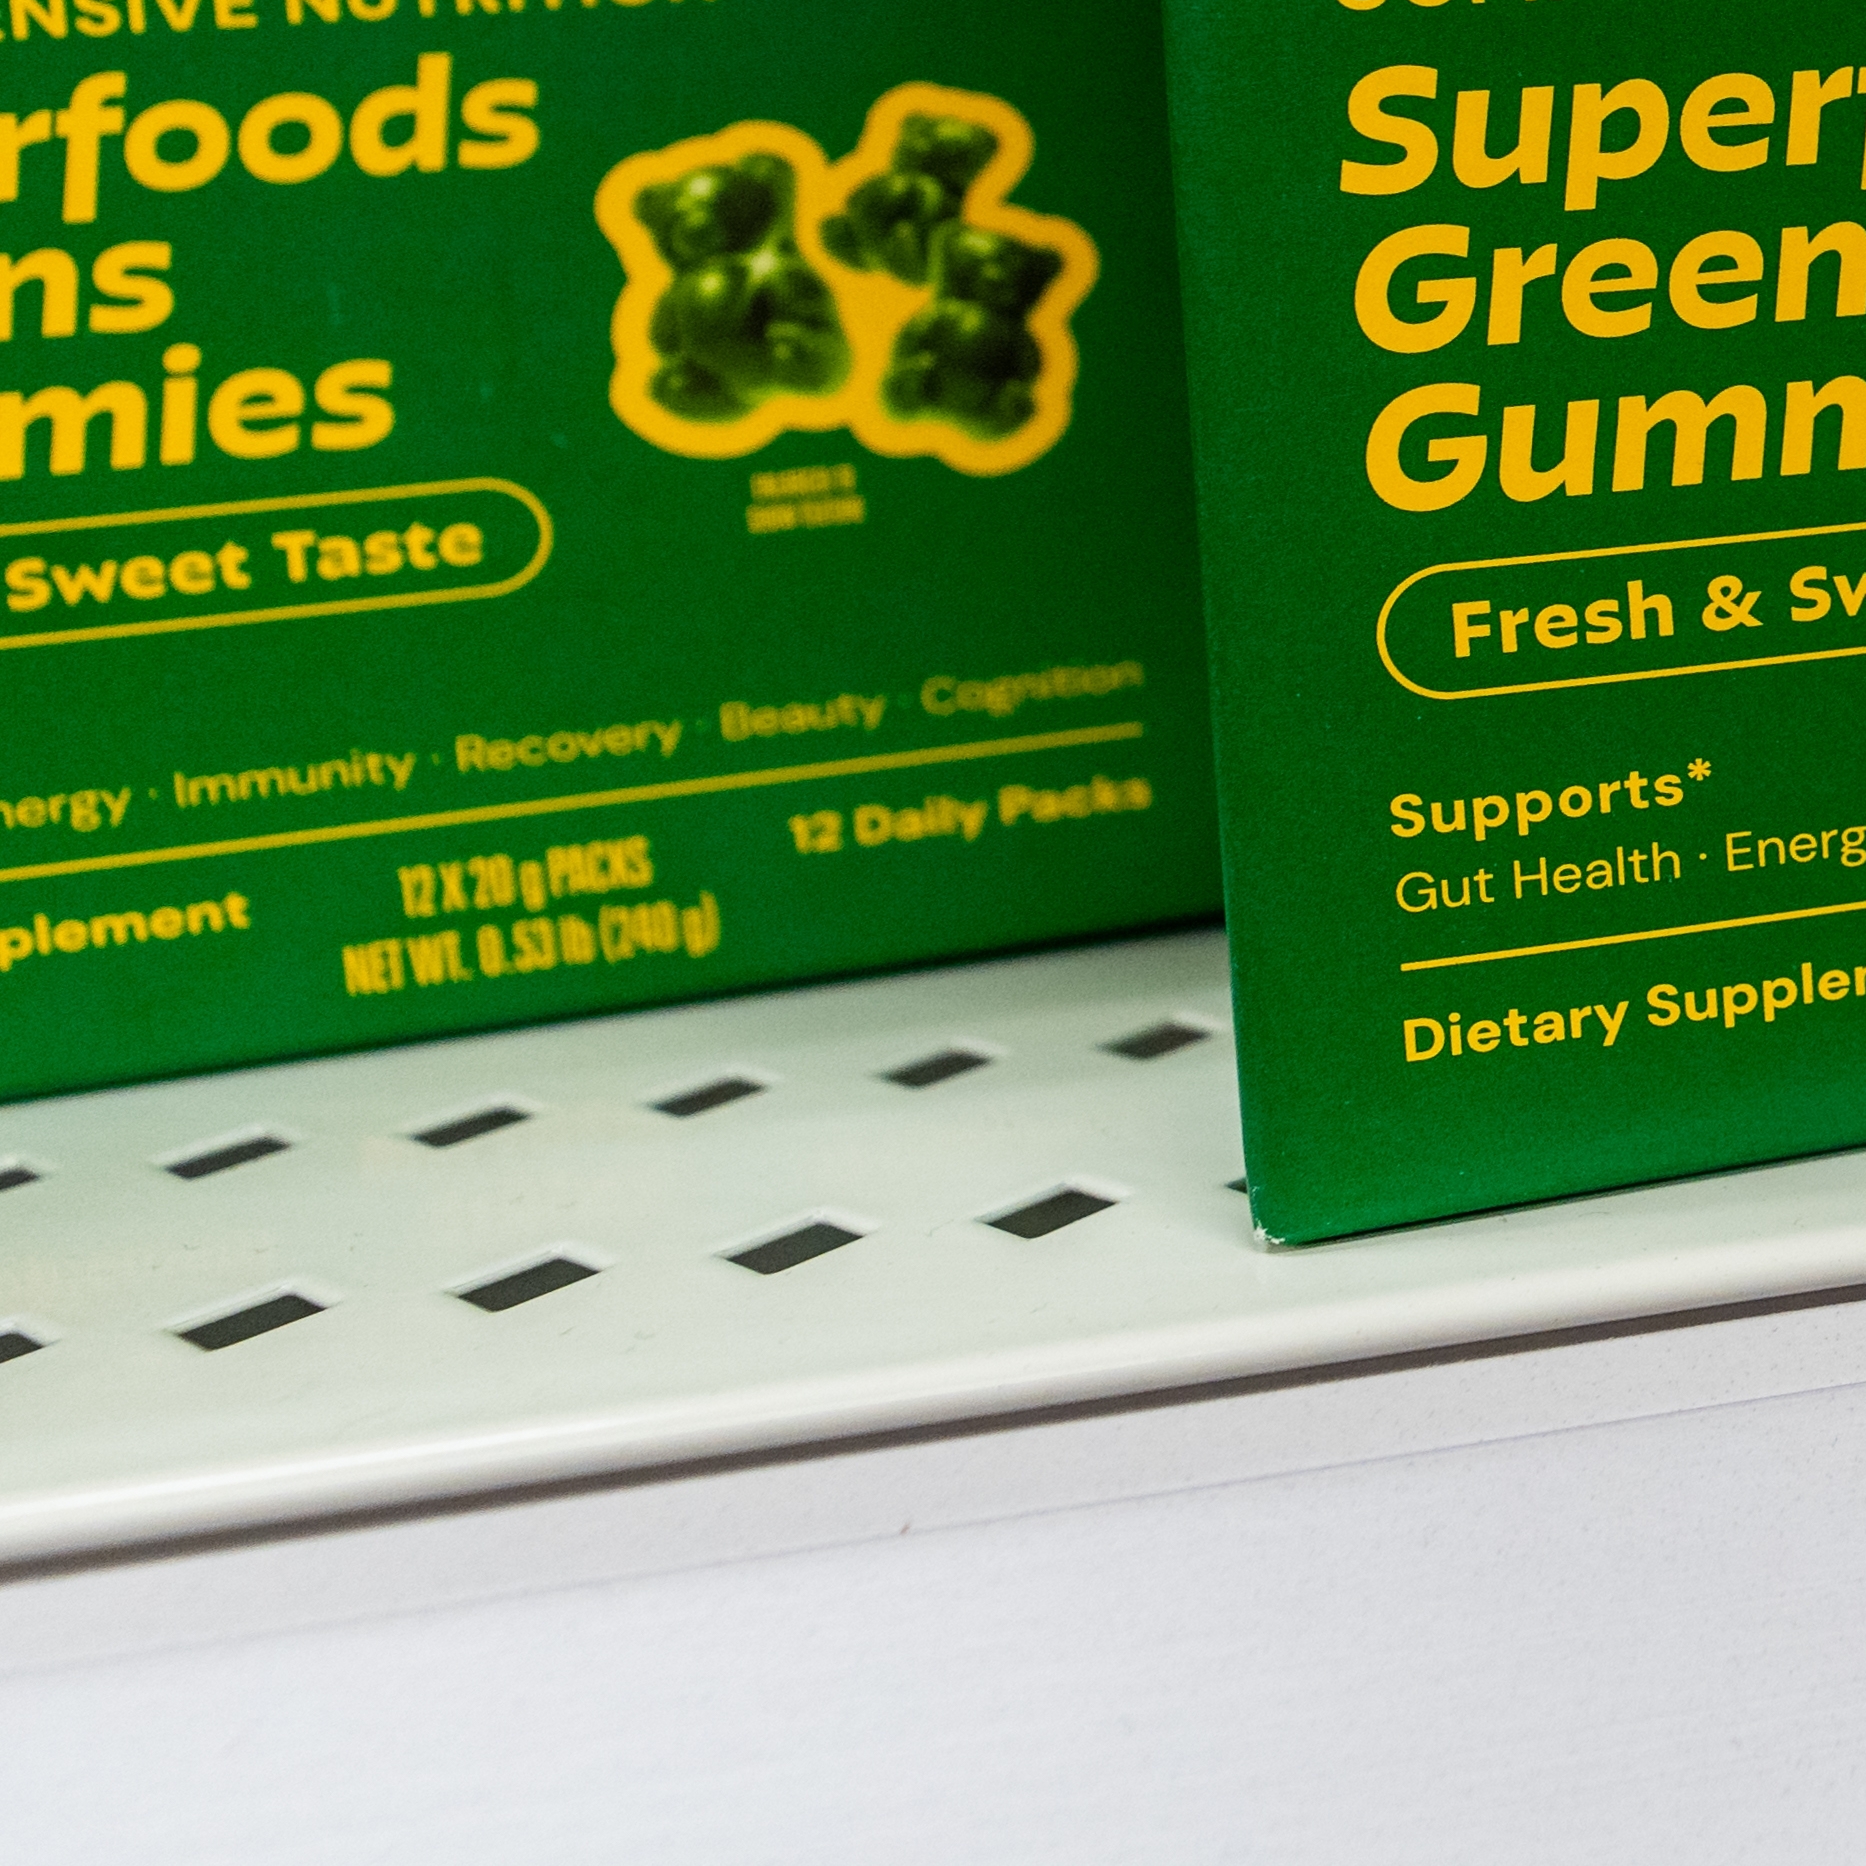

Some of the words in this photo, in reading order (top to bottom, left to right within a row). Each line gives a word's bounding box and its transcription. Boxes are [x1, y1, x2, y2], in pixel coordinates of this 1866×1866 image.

[5, 542, 251, 612] Sweet
[272, 523, 482, 583] Taste
[1452, 580, 1674, 658] Fresh
[1702, 575, 1762, 631] &
[174, 753, 414, 806] Immunity
[456, 723, 679, 771] Recovery
[790, 811, 841, 853] 12
[855, 797, 986, 845] Daily
[999, 779, 1150, 824] Packs
[398, 865, 435, 917] 12
[439, 862, 467, 912] X
[466, 854, 516, 909] 20
[546, 836, 652, 896] PACKS
[1396, 869, 1494, 912] Gut
[1514, 842, 1680, 899] Health
[343, 939, 403, 995] NET
[1404, 1001, 1628, 1062] Dietary
